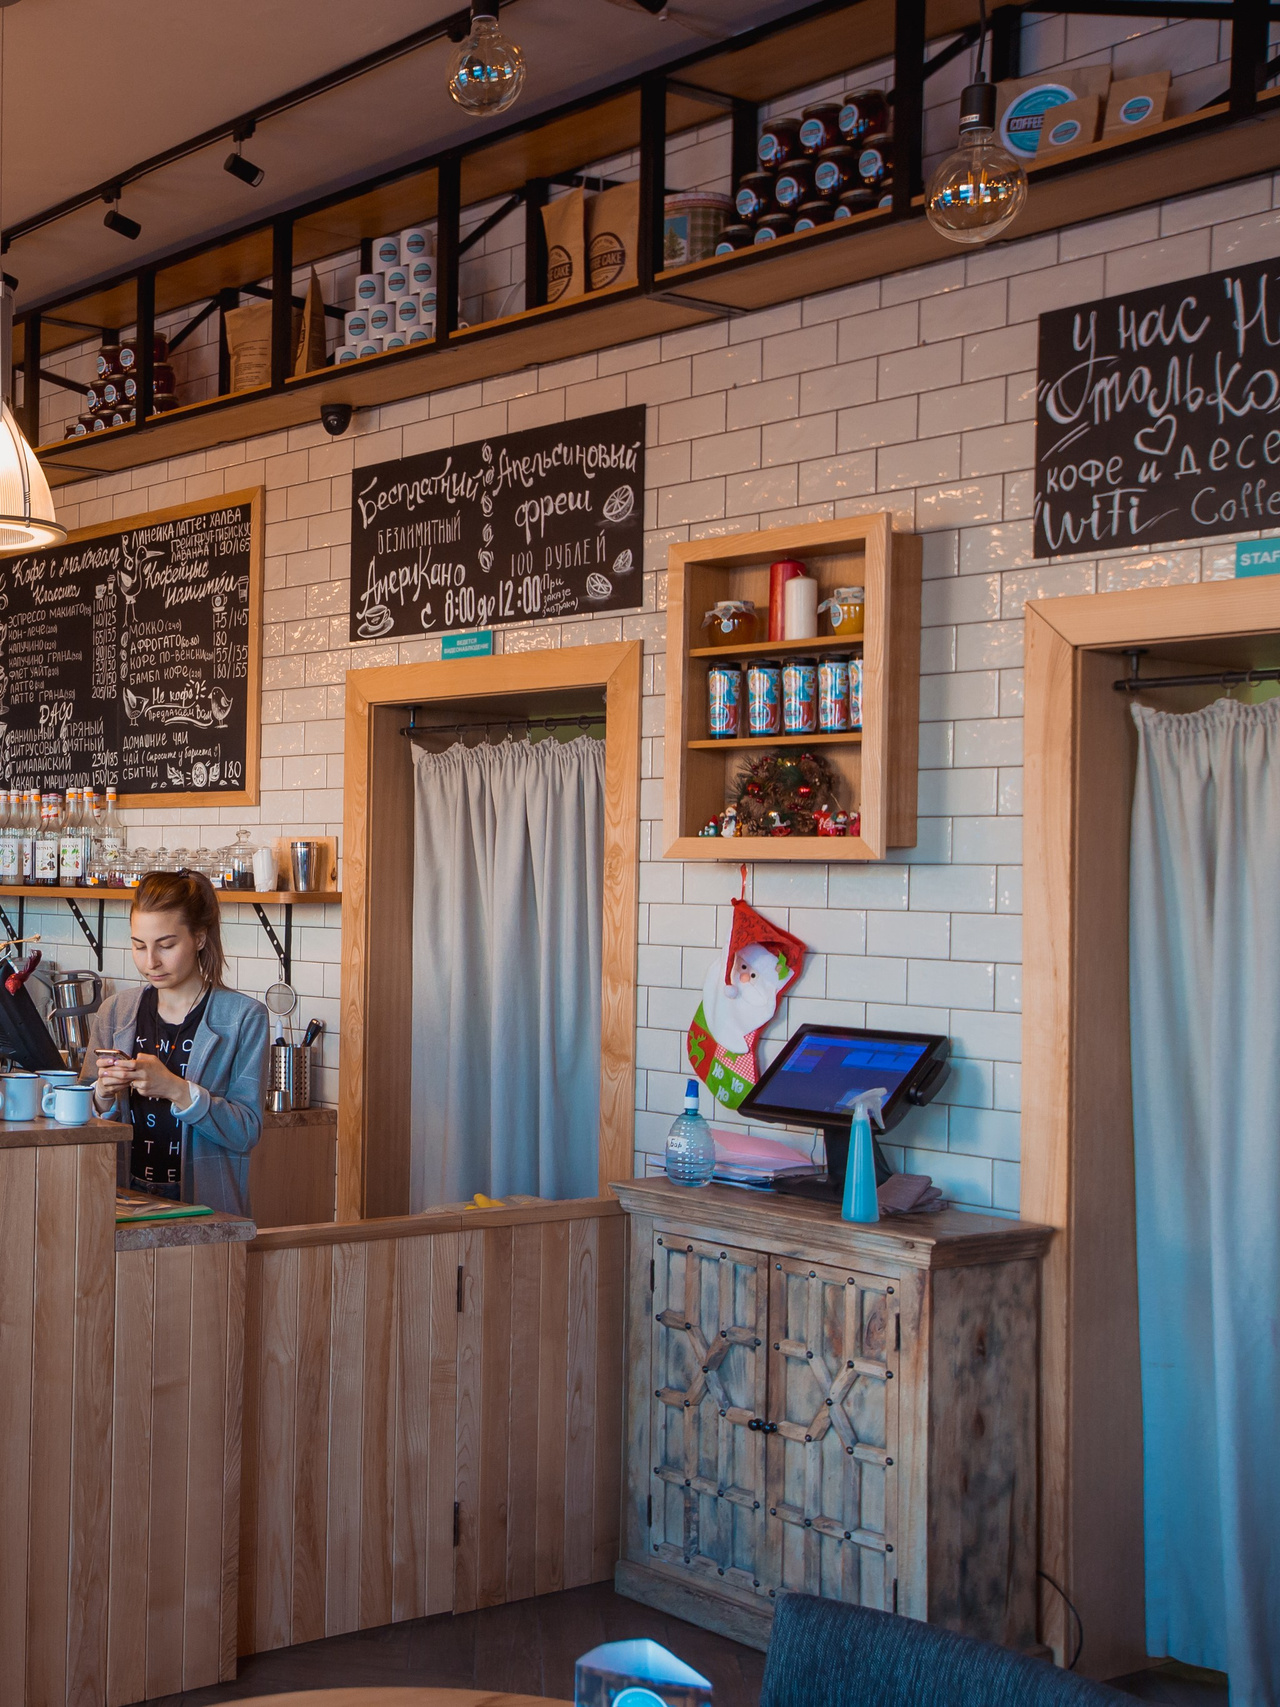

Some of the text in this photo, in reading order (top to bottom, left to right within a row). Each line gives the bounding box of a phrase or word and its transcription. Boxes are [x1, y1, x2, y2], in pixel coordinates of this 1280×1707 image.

[1046, 456, 1123, 494] кофе
[1138, 460, 1162, 483] и
[358, 441, 641, 530] Бесплатный Апельсиновый
[209, 508, 241, 528] ХАЛВА
[378, 509, 462, 555] БЕЗЛИМИТНЫЙ
[511, 529, 606, 577] 100 РУБЛЕЙ
[445, 586, 474, 626] 8:00
[476, 594, 496, 627] до
[499, 575, 541, 617] 12:00
[8, 609, 46, 628] ЭСПРЕССО
[213, 631, 227, 646] 180
[130, 654, 156, 670] КОФЕ
[130, 669, 160, 685] БАМБЛ
[152, 687, 165, 704] Не
[10, 736, 104, 758] ЦИТРУСОВЫЙ МЯТНЫЙ
[10, 753, 72, 774] ГИМАЛАЙСКИЙ
[224, 760, 242, 778] 180
